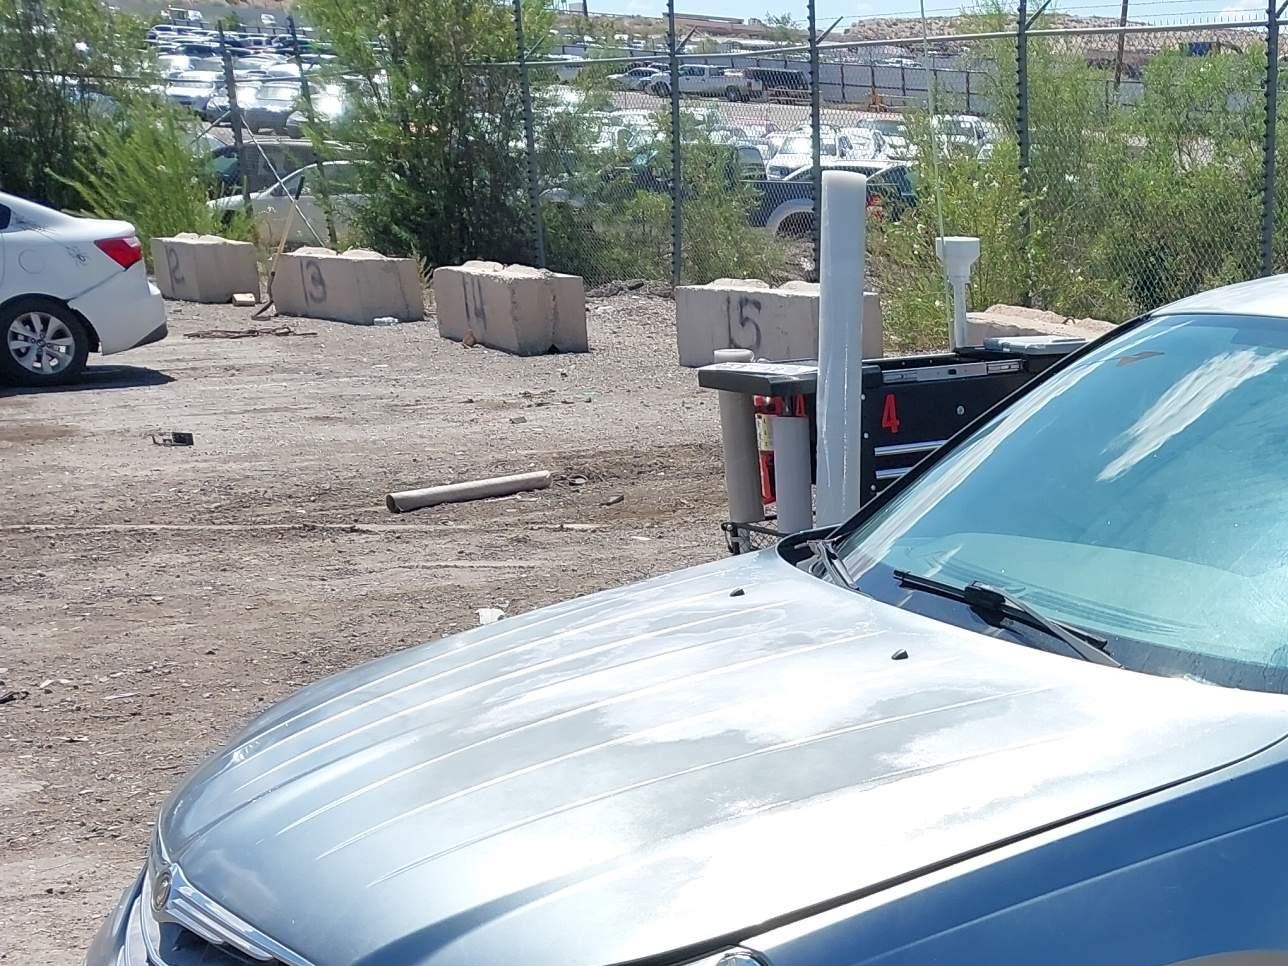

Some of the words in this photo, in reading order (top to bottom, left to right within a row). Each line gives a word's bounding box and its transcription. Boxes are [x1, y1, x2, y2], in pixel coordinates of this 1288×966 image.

[300, 258, 327, 305] 13
[726, 296, 762, 348] 15
[881, 393, 900, 433] 4
